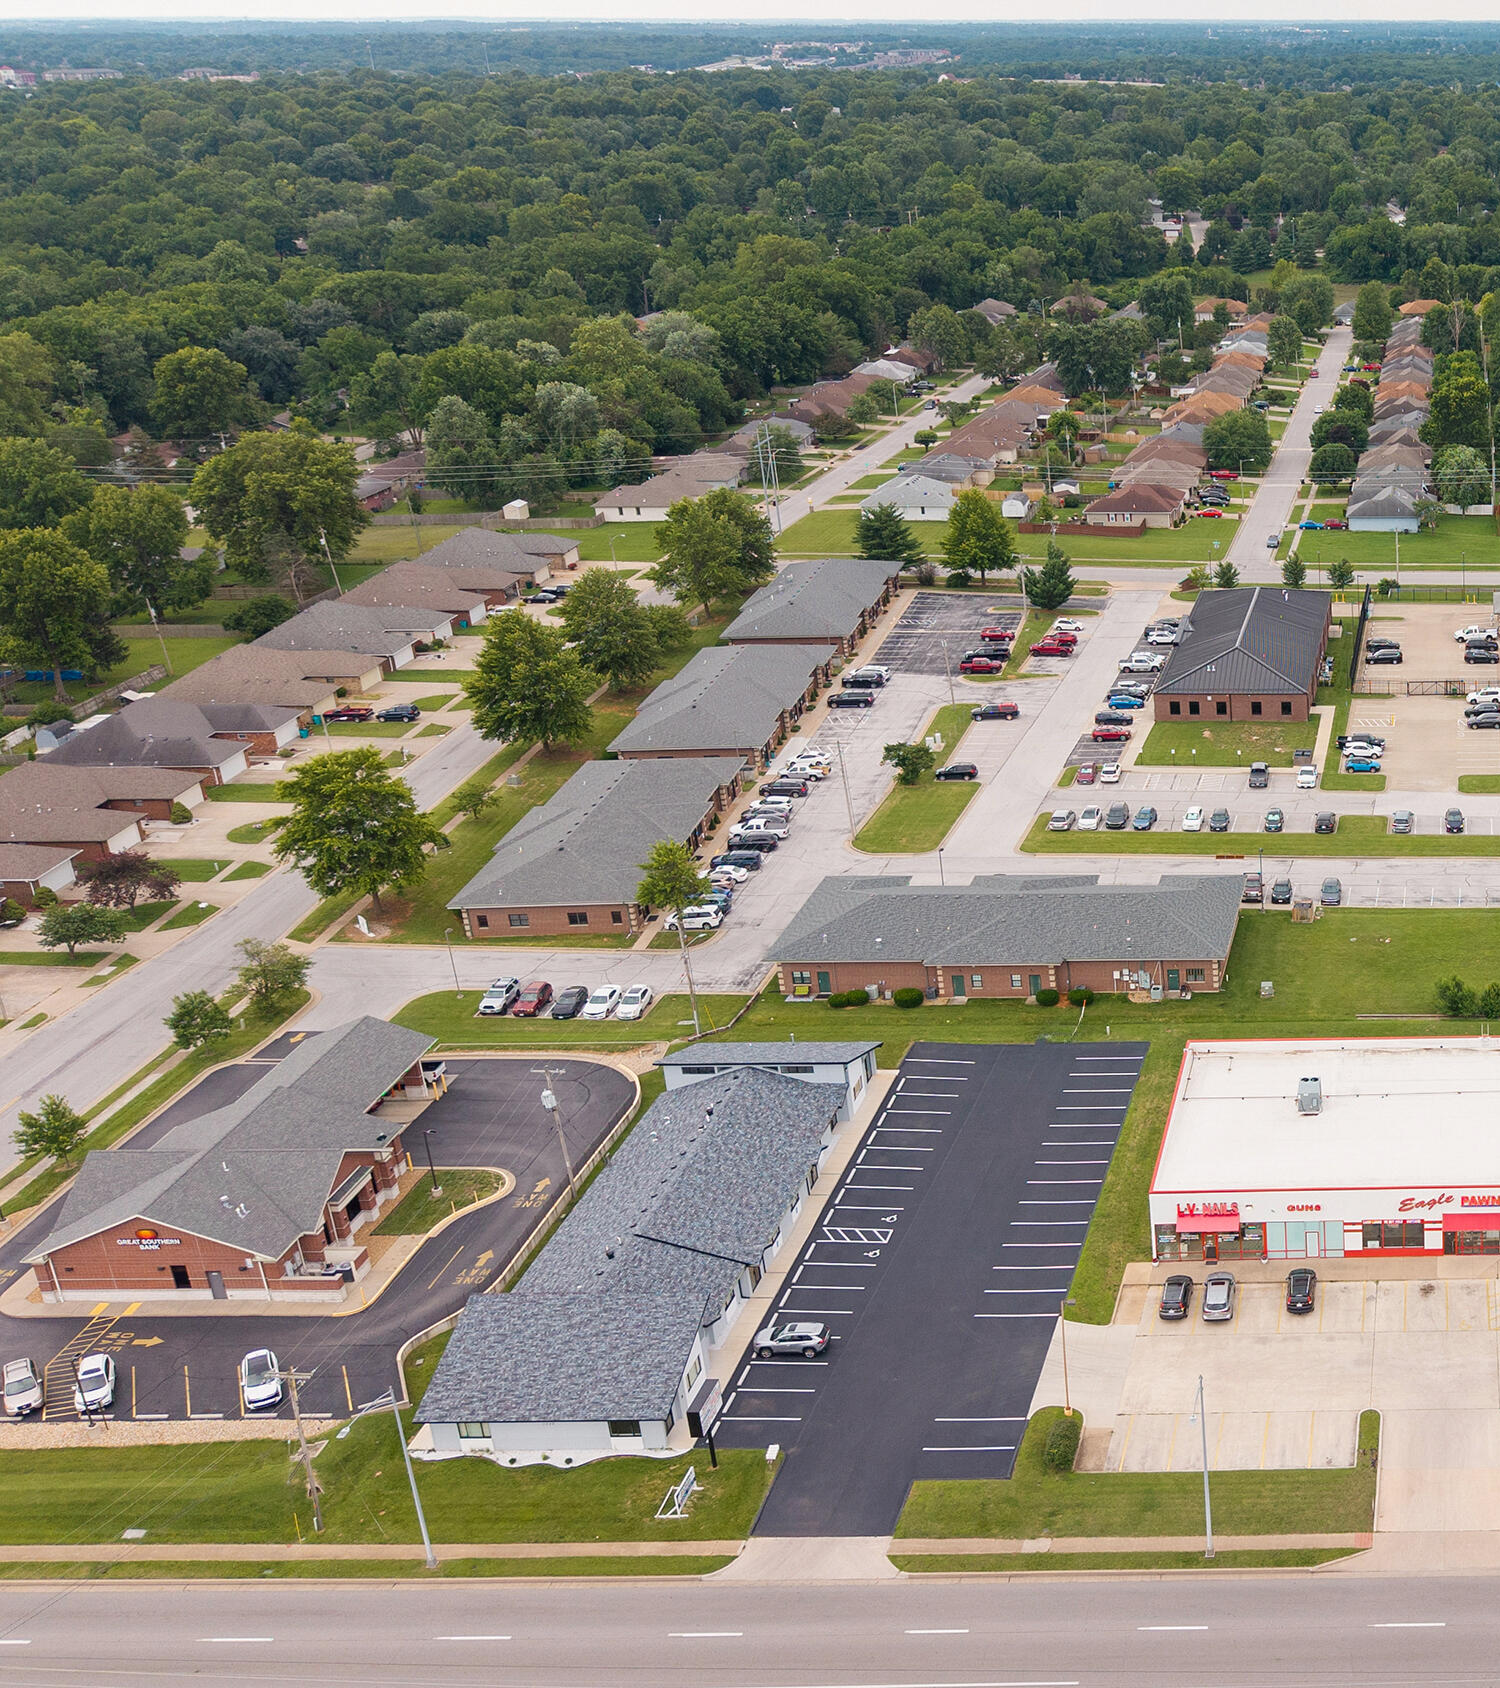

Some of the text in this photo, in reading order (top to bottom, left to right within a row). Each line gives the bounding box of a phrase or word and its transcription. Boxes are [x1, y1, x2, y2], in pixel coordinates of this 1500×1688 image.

[512, 1200, 544, 1208] ONE
[1397, 1193, 1455, 1212] Eagle
[1202, 1202, 1240, 1217] NAILS
[1287, 1204, 1322, 1212] GUNS
[458, 1268, 492, 1277] WAY
[452, 1276, 486, 1285] ONE
